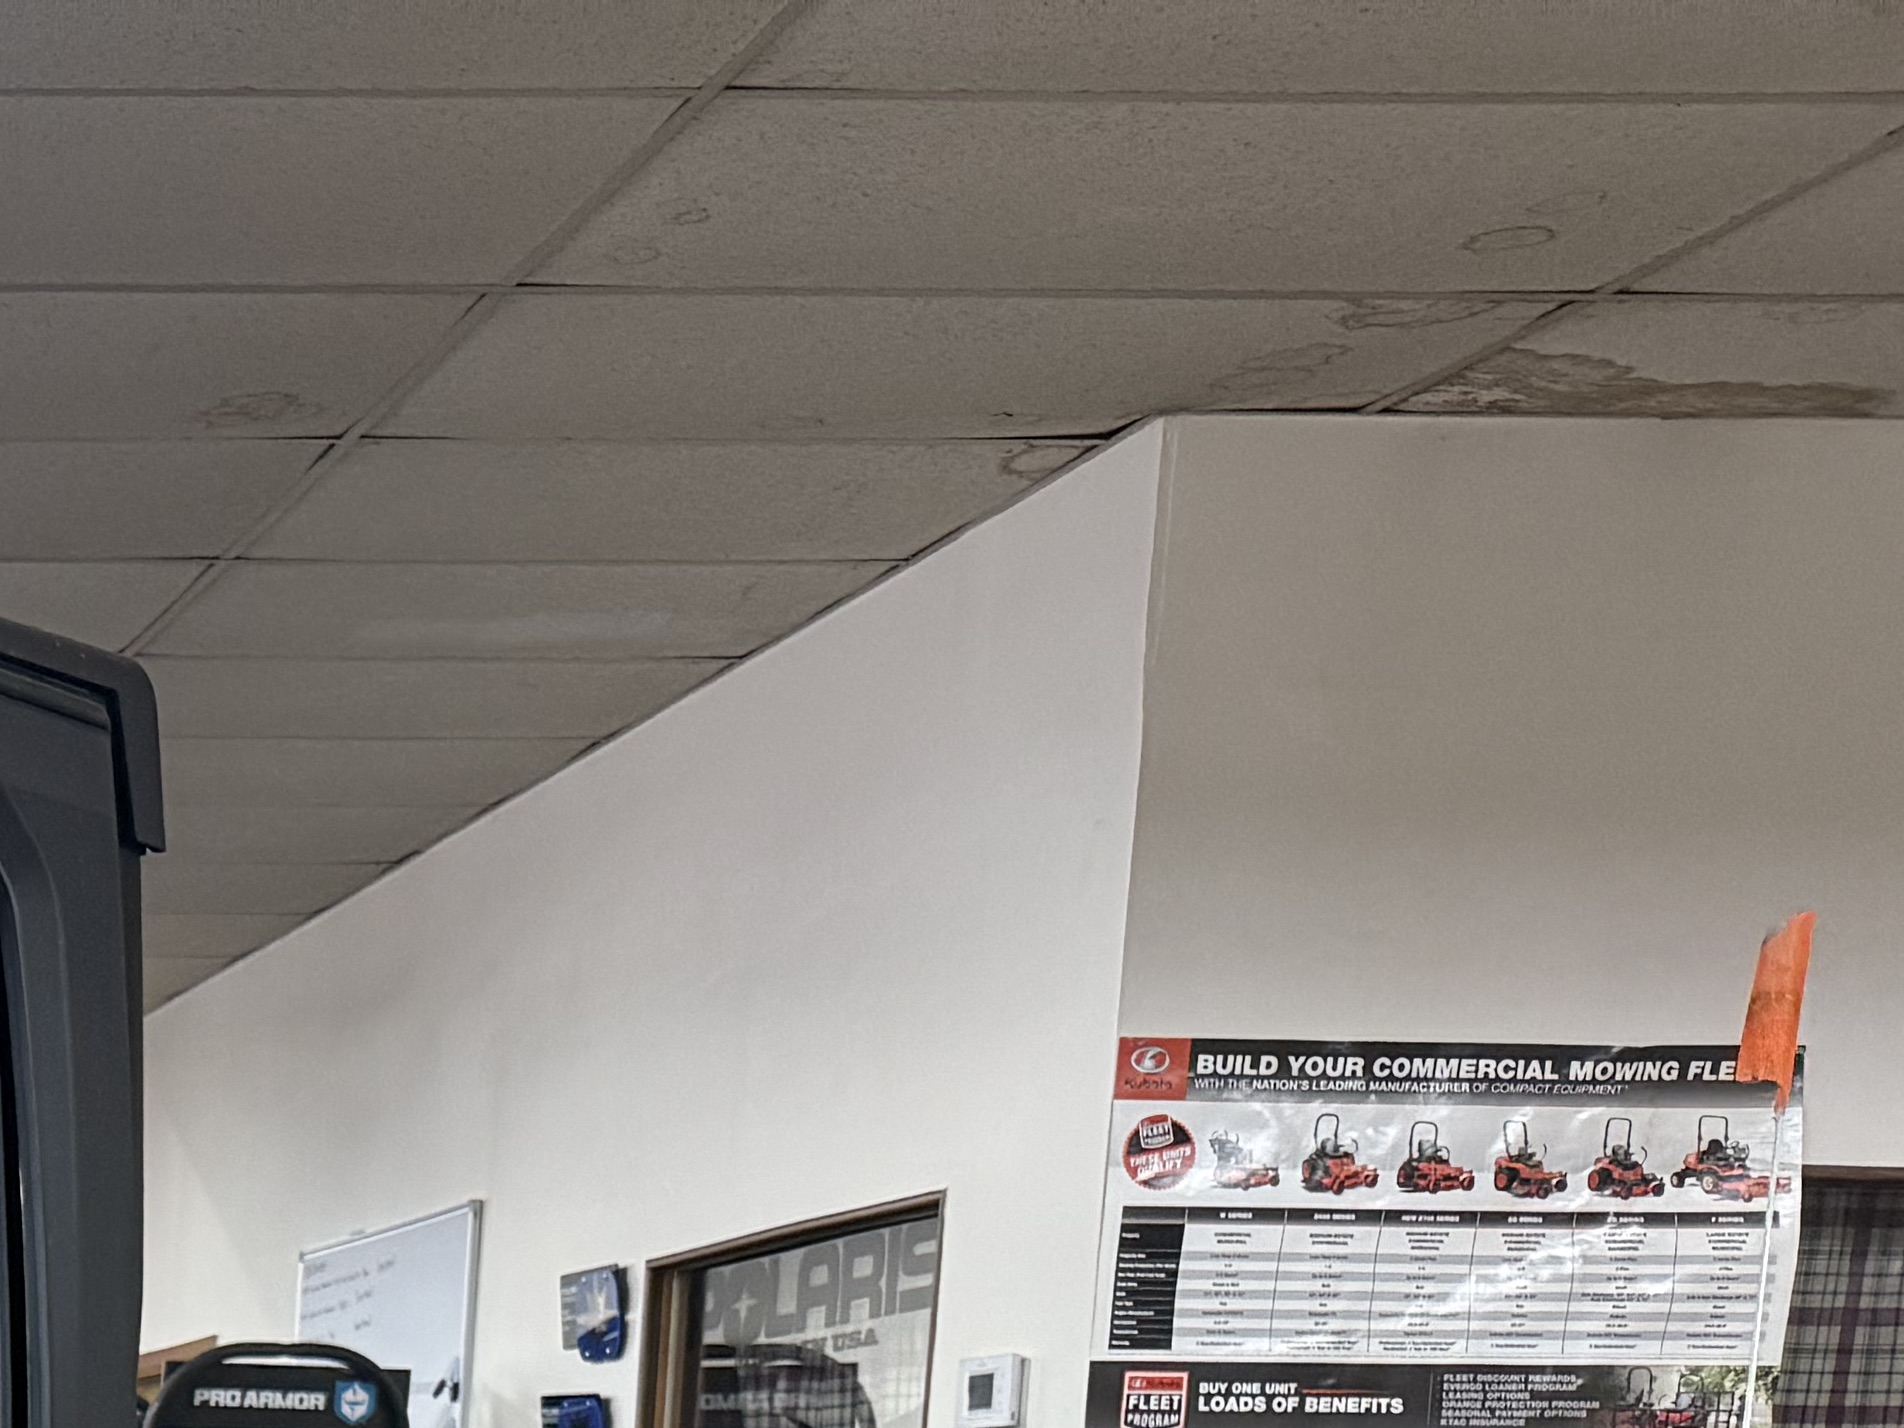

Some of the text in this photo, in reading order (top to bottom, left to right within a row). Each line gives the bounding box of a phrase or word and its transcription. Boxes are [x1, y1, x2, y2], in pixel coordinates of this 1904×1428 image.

[1196, 1055, 1282, 1077] BUILD
[1288, 1056, 1364, 1078] YOUR
[1373, 1056, 1560, 1081] COMMERCIAL
[1569, 1060, 1679, 1082] MOWING
[1194, 1078, 1226, 1090] WITH
[1312, 1080, 1366, 1092] LEADING
[1369, 1081, 1470, 1094] MANUFACTURER
[1473, 1082, 1489, 1093] OF
[1491, 1083, 1551, 1095] COMPACT
[1443, 1374, 1577, 1383] FLEET DISCOUNT REWARDS
[1199, 1382, 1298, 1395] BUY ONE UNIT
[1486, 1392, 1530, 1400] OPTIONS
[1128, 1395, 1181, 1411] FLEET
[1198, 1396, 1404, 1414] LOADS OF BENEFITS
[1127, 1412, 1179, 1428] PROGRAM
